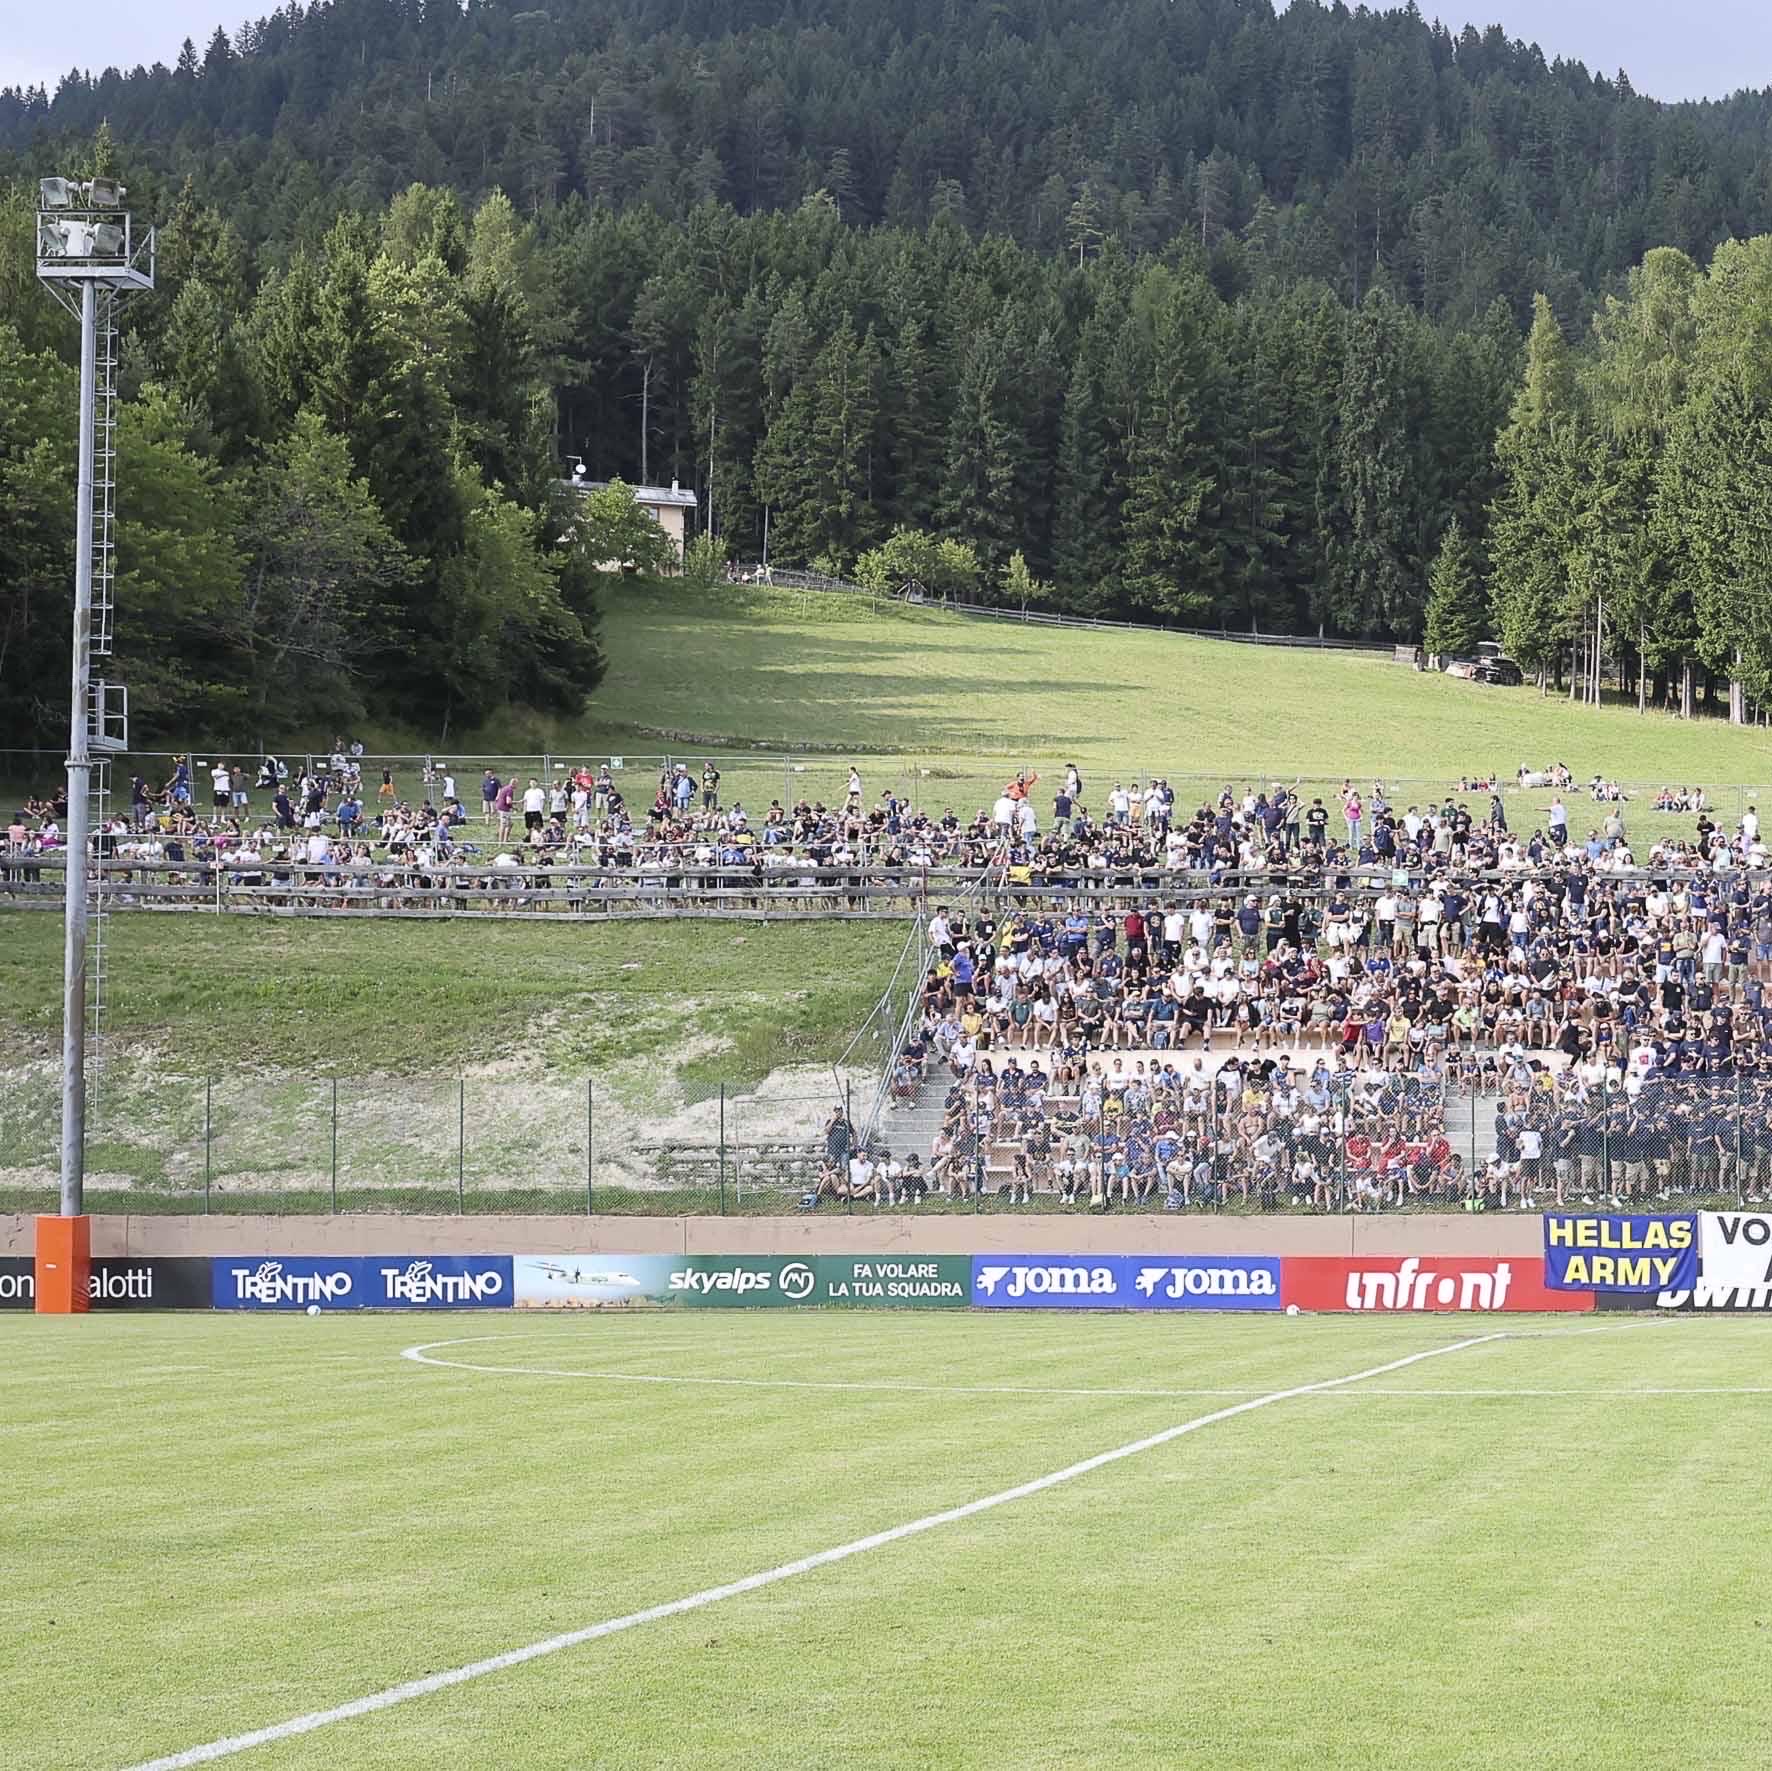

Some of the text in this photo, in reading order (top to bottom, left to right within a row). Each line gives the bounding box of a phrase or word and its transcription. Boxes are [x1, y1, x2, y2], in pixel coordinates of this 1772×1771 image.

[1549, 1218, 1692, 1249] HELLAS
[232, 1267, 352, 1303] TRENTINO
[380, 1267, 502, 1303] TRENTINO
[668, 1267, 771, 1294] skyalps
[853, 1263, 938, 1278] FA VOLARE
[1346, 1257, 1512, 1309] infront
[1564, 1255, 1677, 1286] ARMY
[829, 1282, 963, 1297] LA TUA SQUADRA
